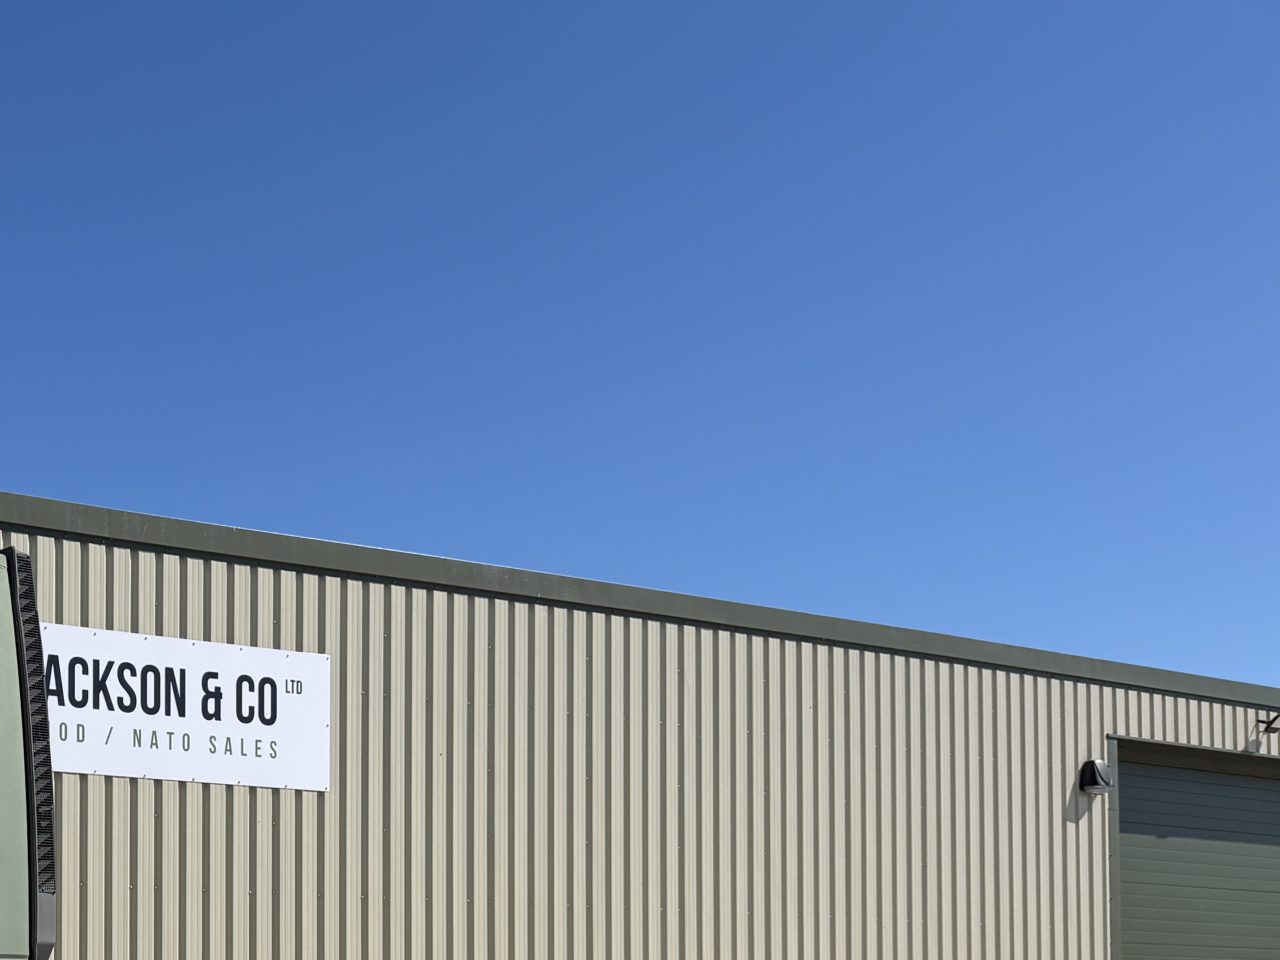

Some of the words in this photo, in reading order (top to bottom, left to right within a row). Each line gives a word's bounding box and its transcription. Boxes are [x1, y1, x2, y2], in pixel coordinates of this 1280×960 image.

[201, 671, 223, 721] &
[236, 674, 278, 726] CO
[285, 679, 303, 695] LTD
[104, 726, 114, 745] /
[133, 728, 191, 753] NATO
[209, 735, 278, 759] SALES
